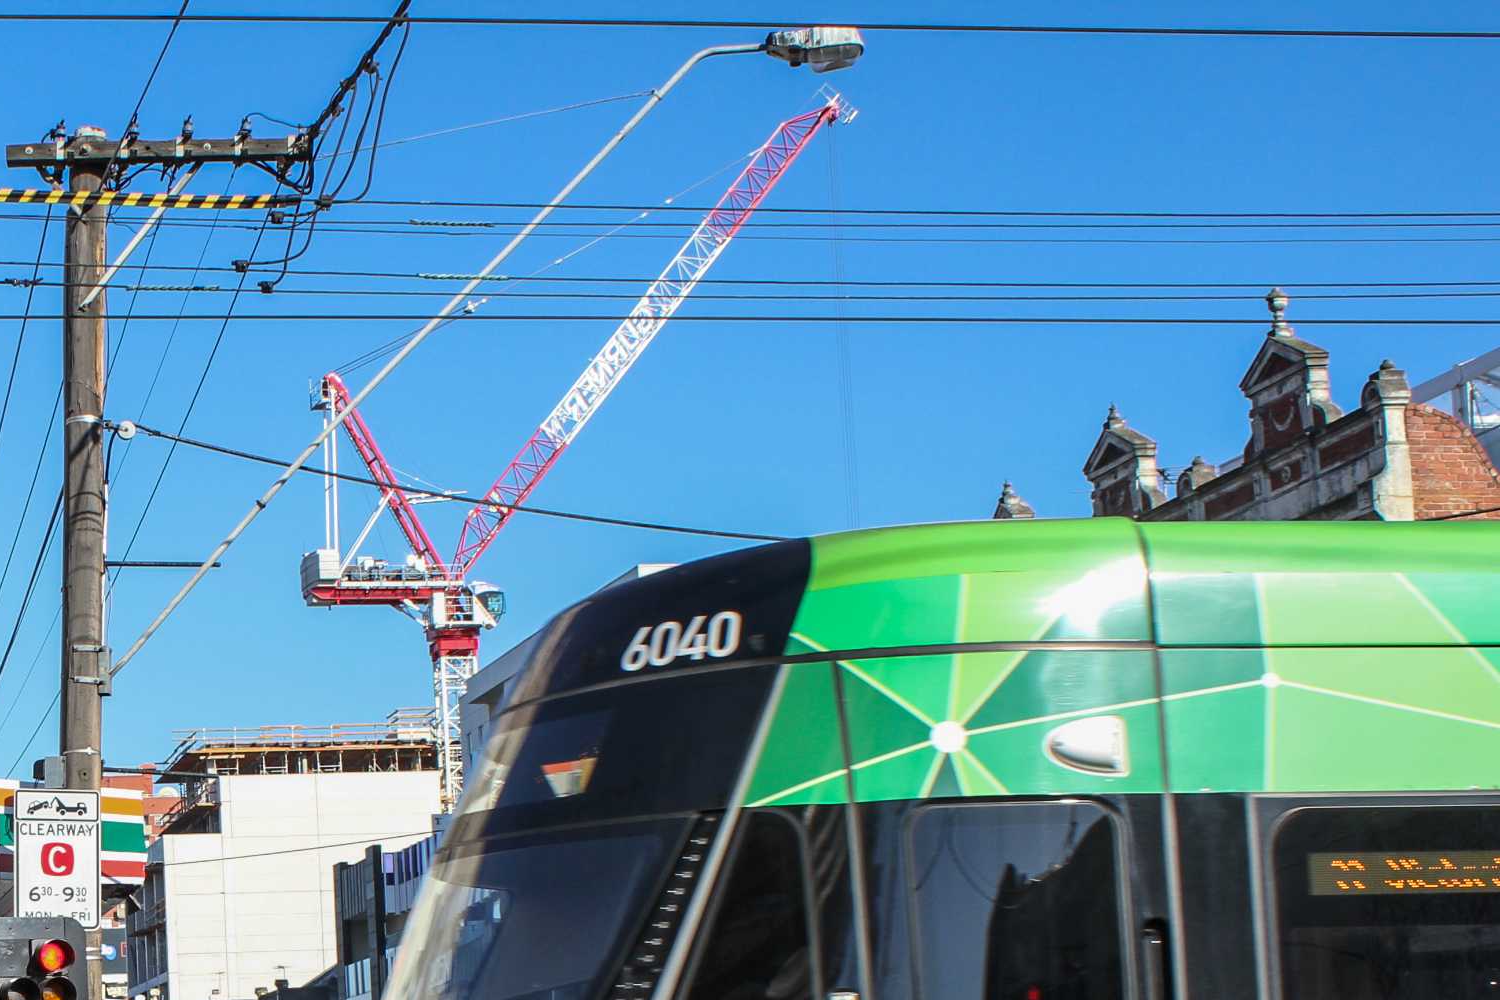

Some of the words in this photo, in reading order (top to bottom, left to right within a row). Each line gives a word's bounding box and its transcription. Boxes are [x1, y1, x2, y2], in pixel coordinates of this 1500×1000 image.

[620, 611, 742, 671] 6040
[20, 823, 94, 836] CLEARWAY
[48, 846, 67, 873] C
